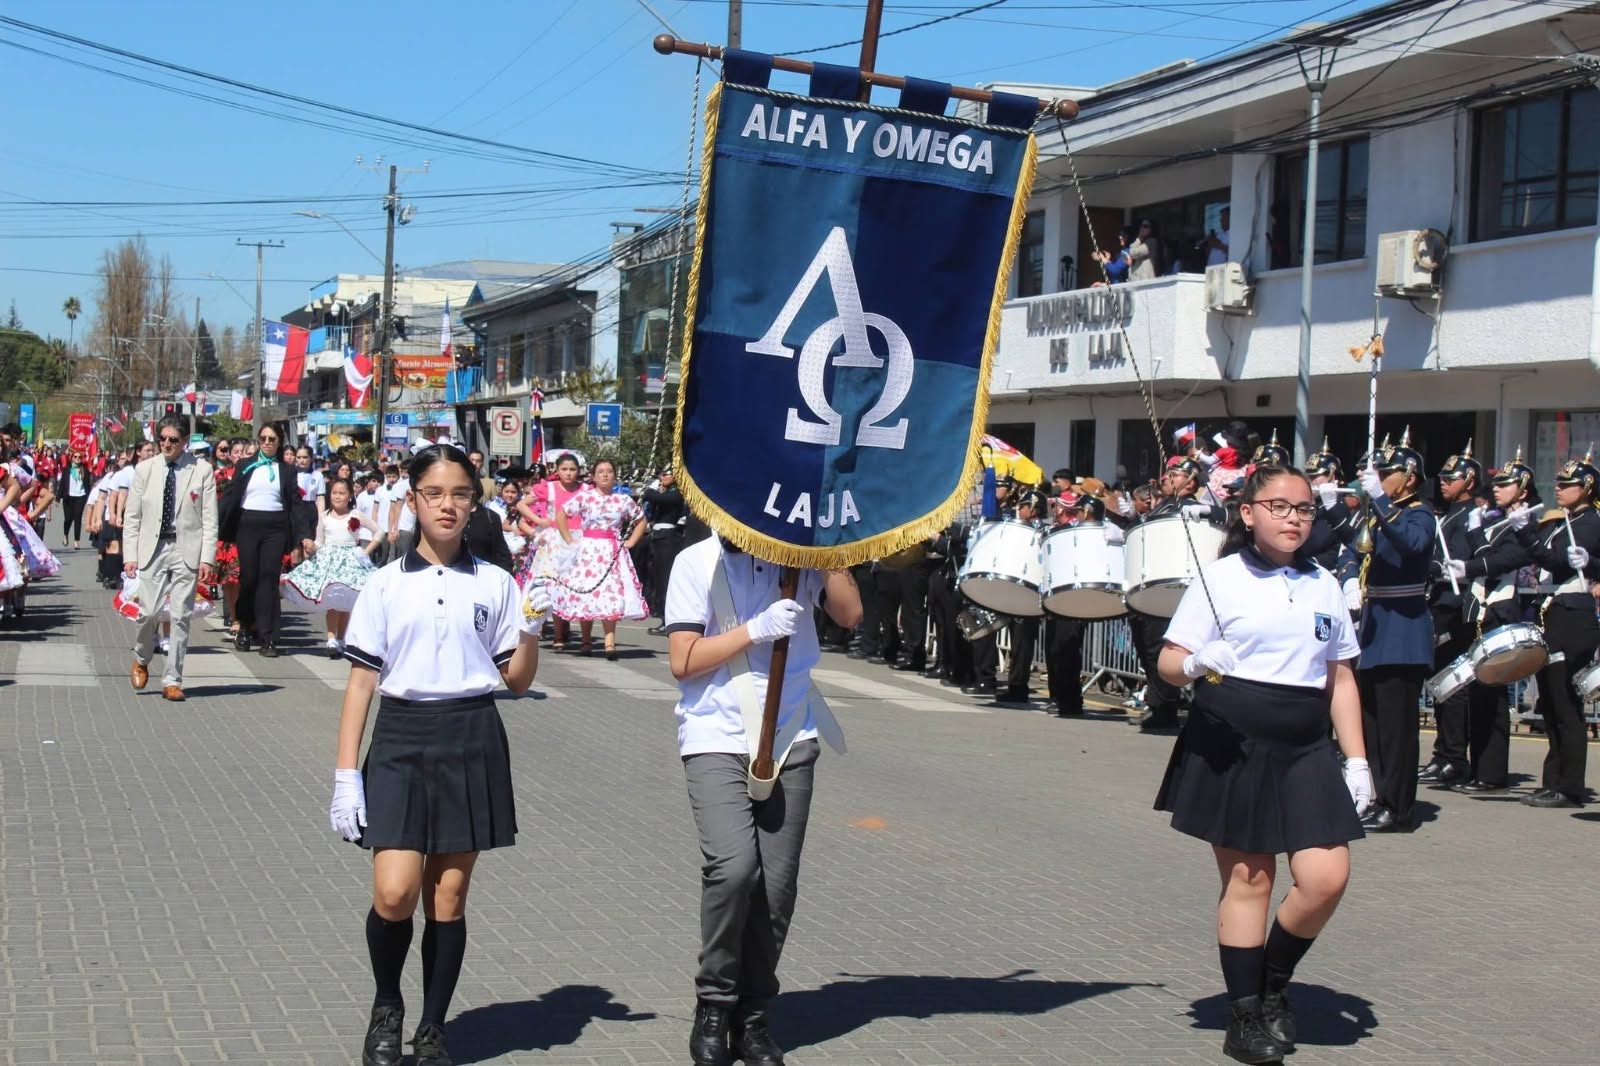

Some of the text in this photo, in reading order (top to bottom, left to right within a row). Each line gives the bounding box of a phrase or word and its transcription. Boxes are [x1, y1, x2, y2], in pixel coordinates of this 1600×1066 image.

[741, 103, 994, 175] ALFA Y OMEGA
[1088, 332, 1124, 363] LAJA
[394, 415, 400, 423] E
[502, 415, 512, 431] E
[597, 410, 611, 431] E
[763, 482, 861, 528] LAJA
